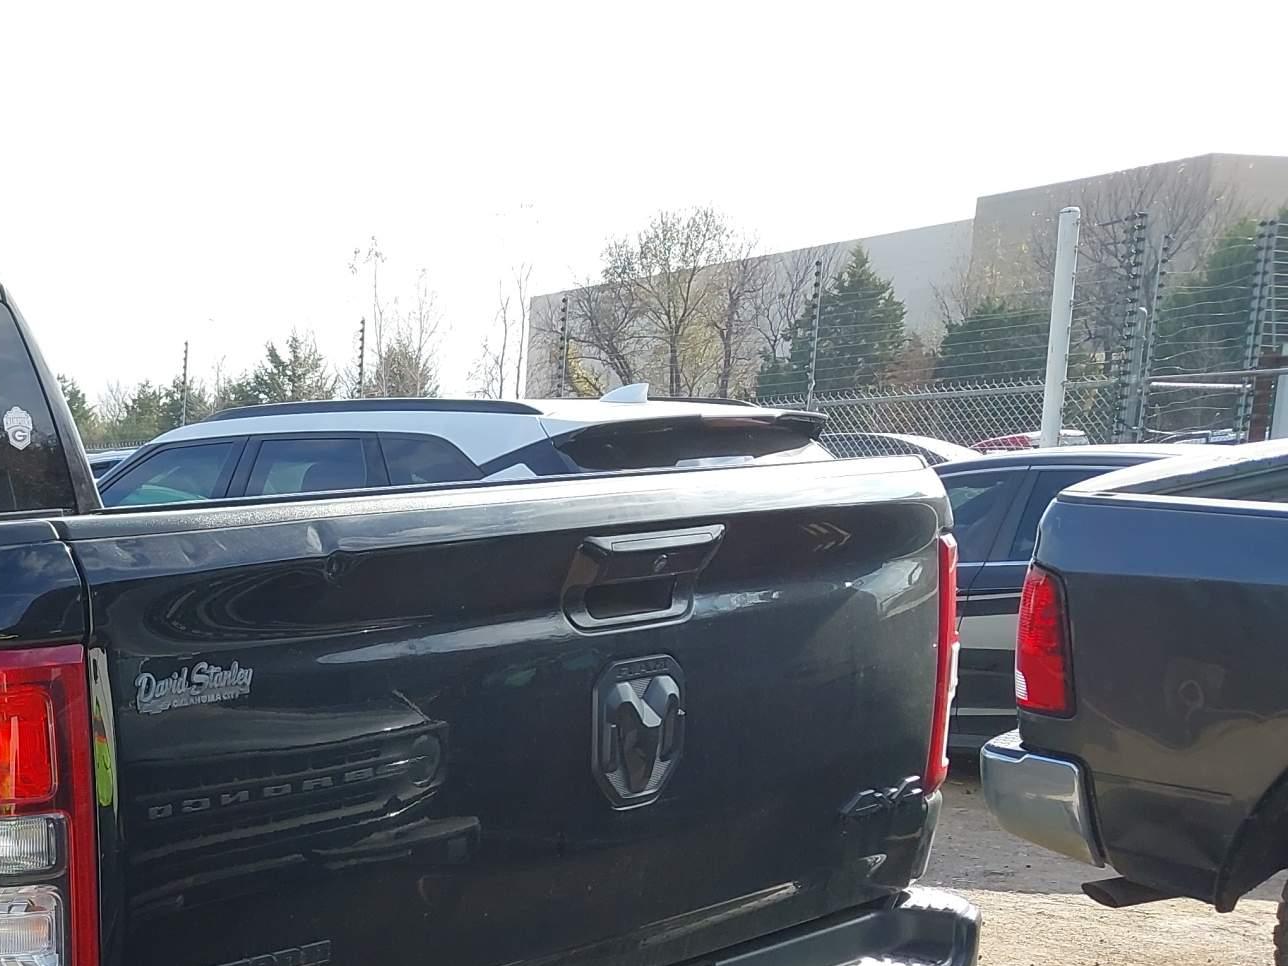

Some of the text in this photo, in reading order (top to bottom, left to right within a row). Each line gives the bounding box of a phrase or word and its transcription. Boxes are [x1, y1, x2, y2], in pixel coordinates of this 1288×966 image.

[135, 661, 253, 703] David Stanley
[615, 661, 670, 678] RAM
